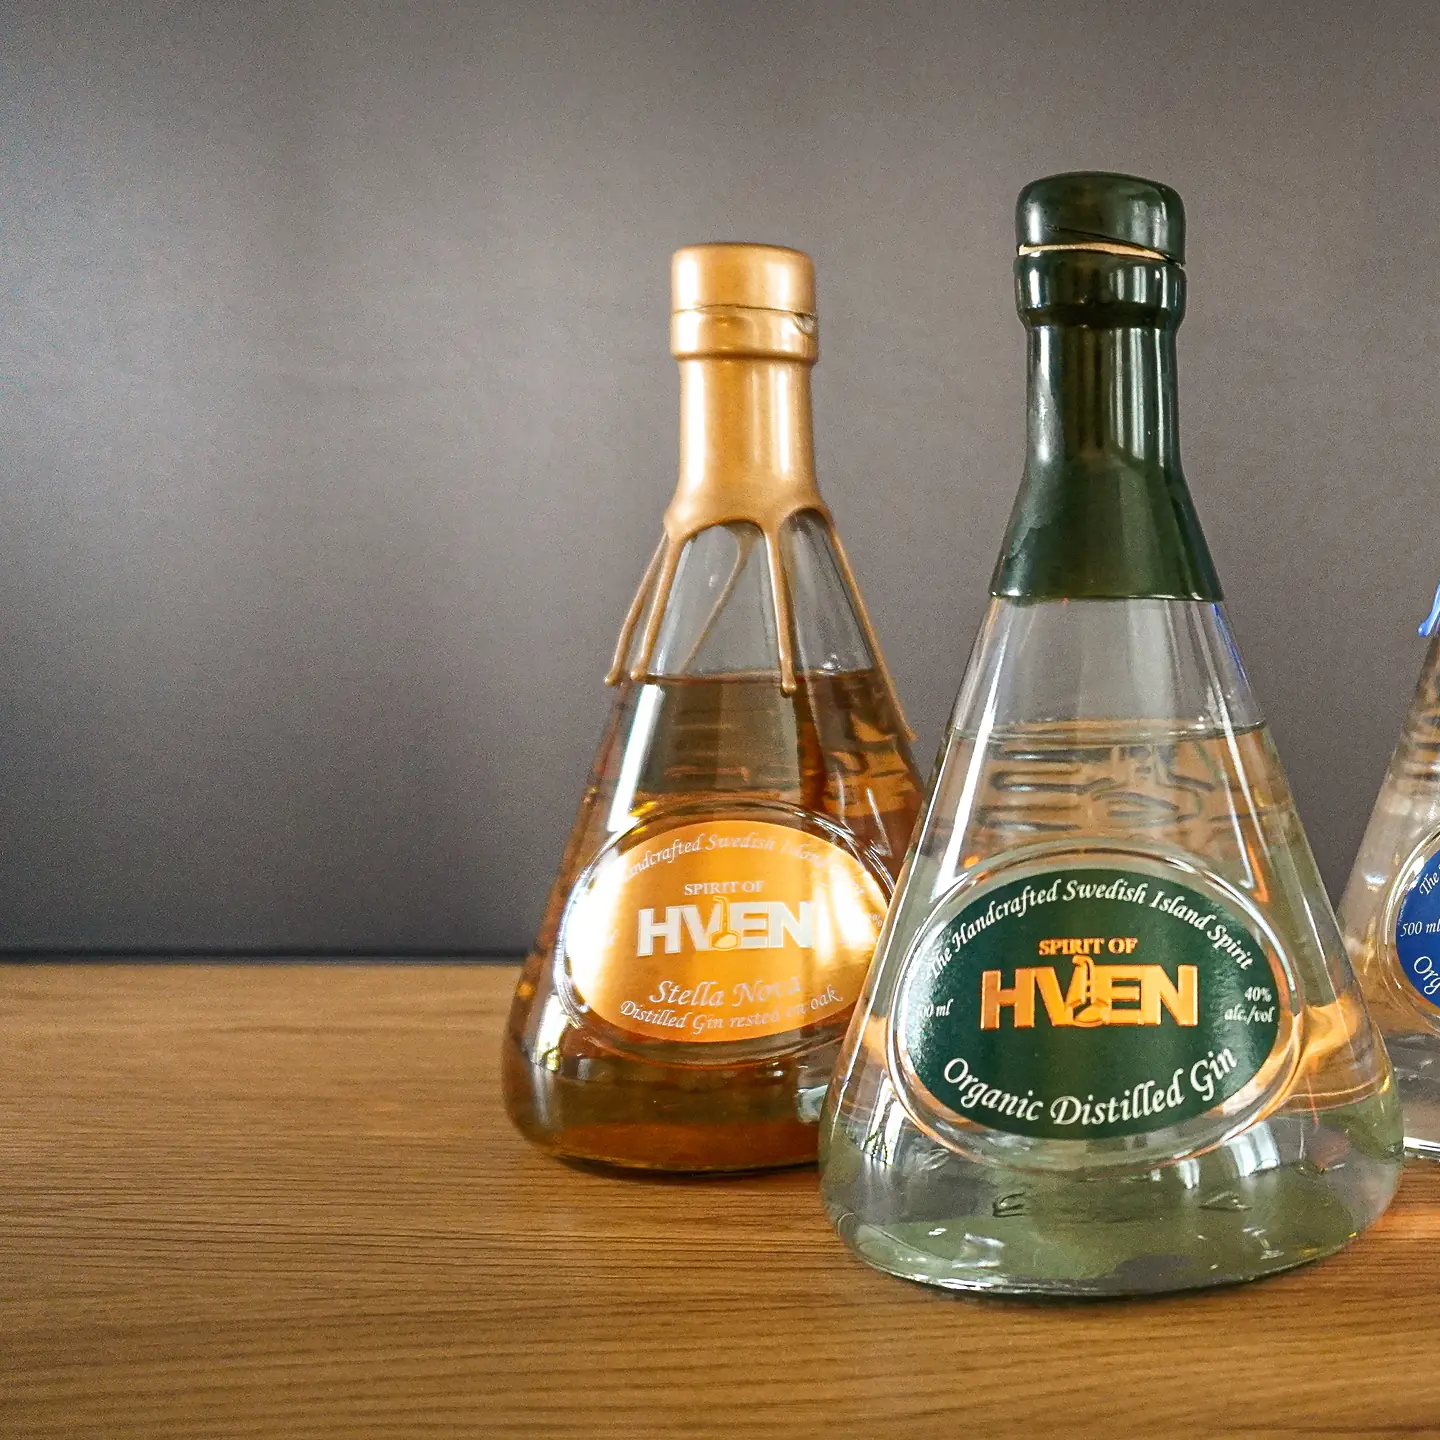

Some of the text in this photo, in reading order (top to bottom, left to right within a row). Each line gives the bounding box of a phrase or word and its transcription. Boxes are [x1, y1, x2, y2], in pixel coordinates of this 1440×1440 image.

[626, 832, 705, 877] andcrafted
[705, 831, 775, 851] Swedish
[684, 880, 765, 896] SPIRIT OF
[1419, 868, 1440, 896] The
[637, 900, 815, 957] HVEN
[951, 878, 1062, 953] Handcrafted
[1063, 878, 1147, 905] Swedish
[1150, 890, 1216, 931] Island
[1206, 923, 1255, 971] Spirit
[1400, 919, 1423, 937] 500
[1039, 937, 1139, 956] SPIRIT OF
[649, 976, 801, 1007] Stella Nova
[980, 964, 1199, 1031] HVEN
[1244, 986, 1272, 1002] 40%
[620, 984, 844, 1035] Distilled Gin rested on oak
[935, 999, 955, 1017] ml
[943, 1047, 1239, 1127] Organic Distilled Gin
